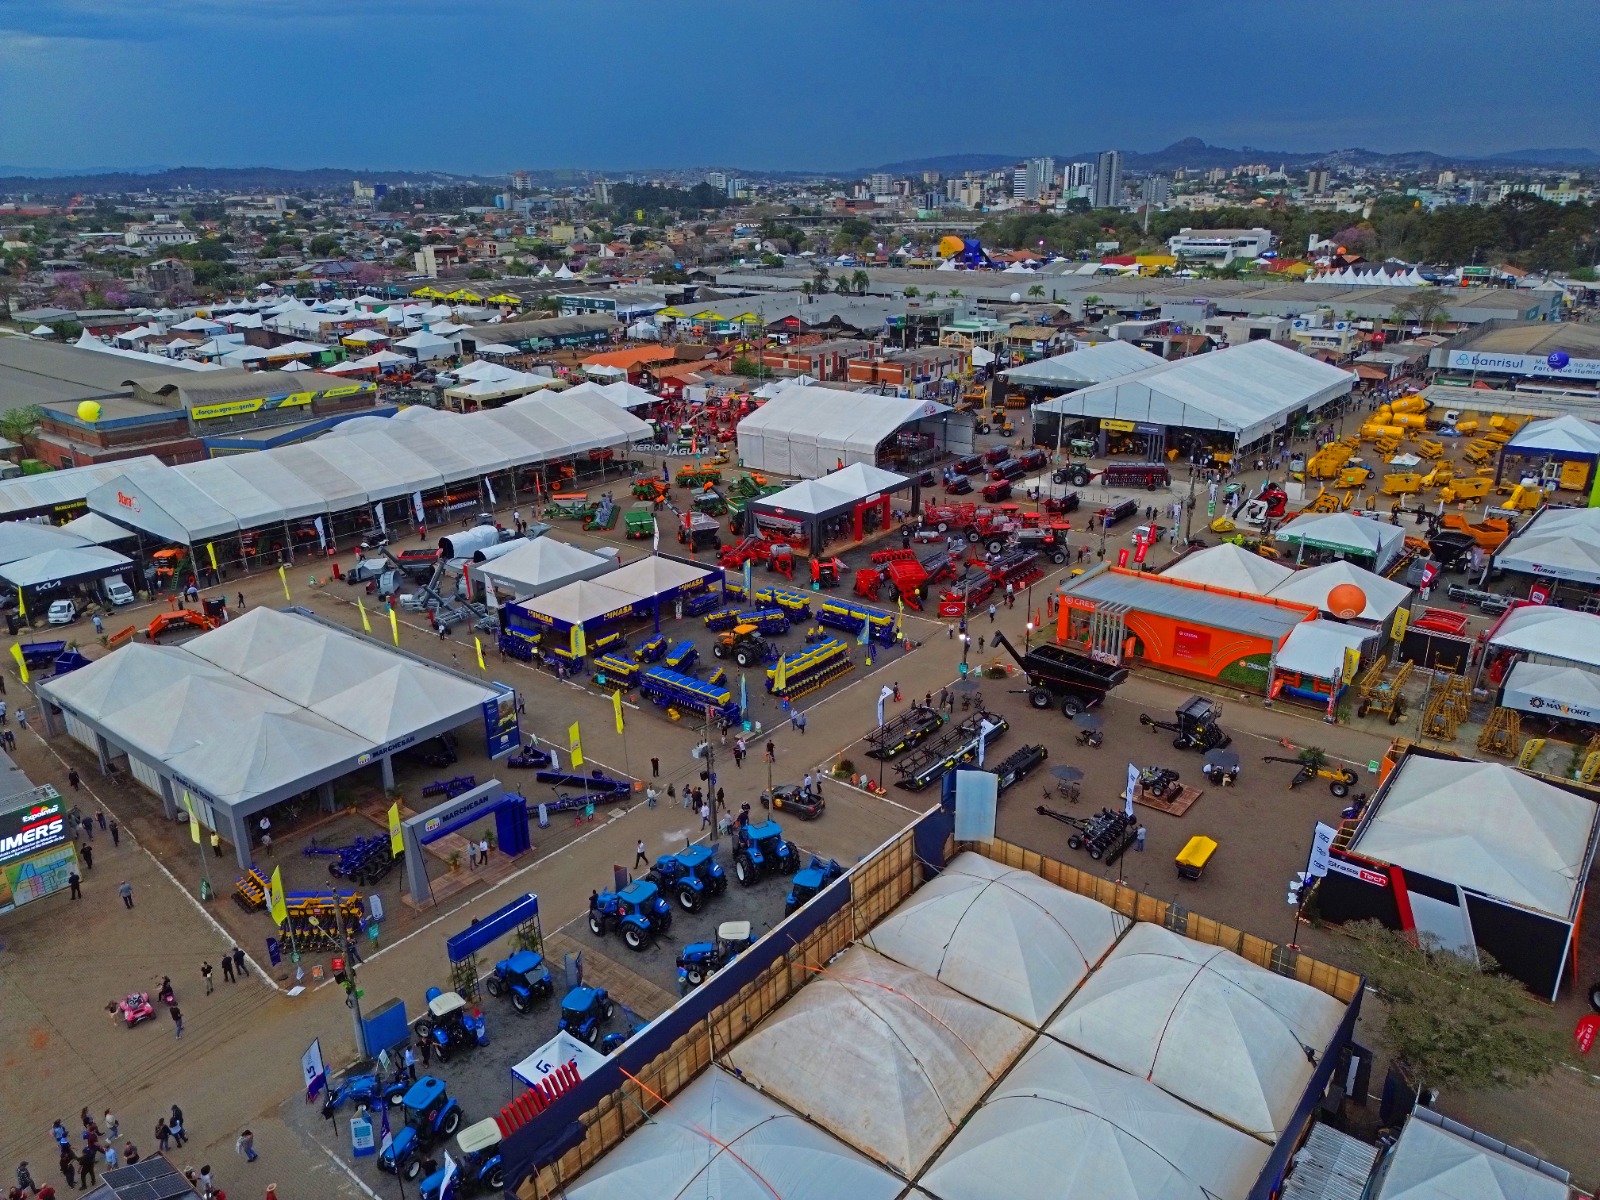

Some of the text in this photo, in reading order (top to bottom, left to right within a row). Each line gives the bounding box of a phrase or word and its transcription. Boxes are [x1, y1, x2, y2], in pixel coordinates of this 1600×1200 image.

[1471, 356, 1524, 368] banrisul
[629, 443, 669, 453] XERION
[372, 736, 416, 758] MARCHESAN
[442, 795, 489, 823] MARCHESAN
[536, 1059, 552, 1074] LS
